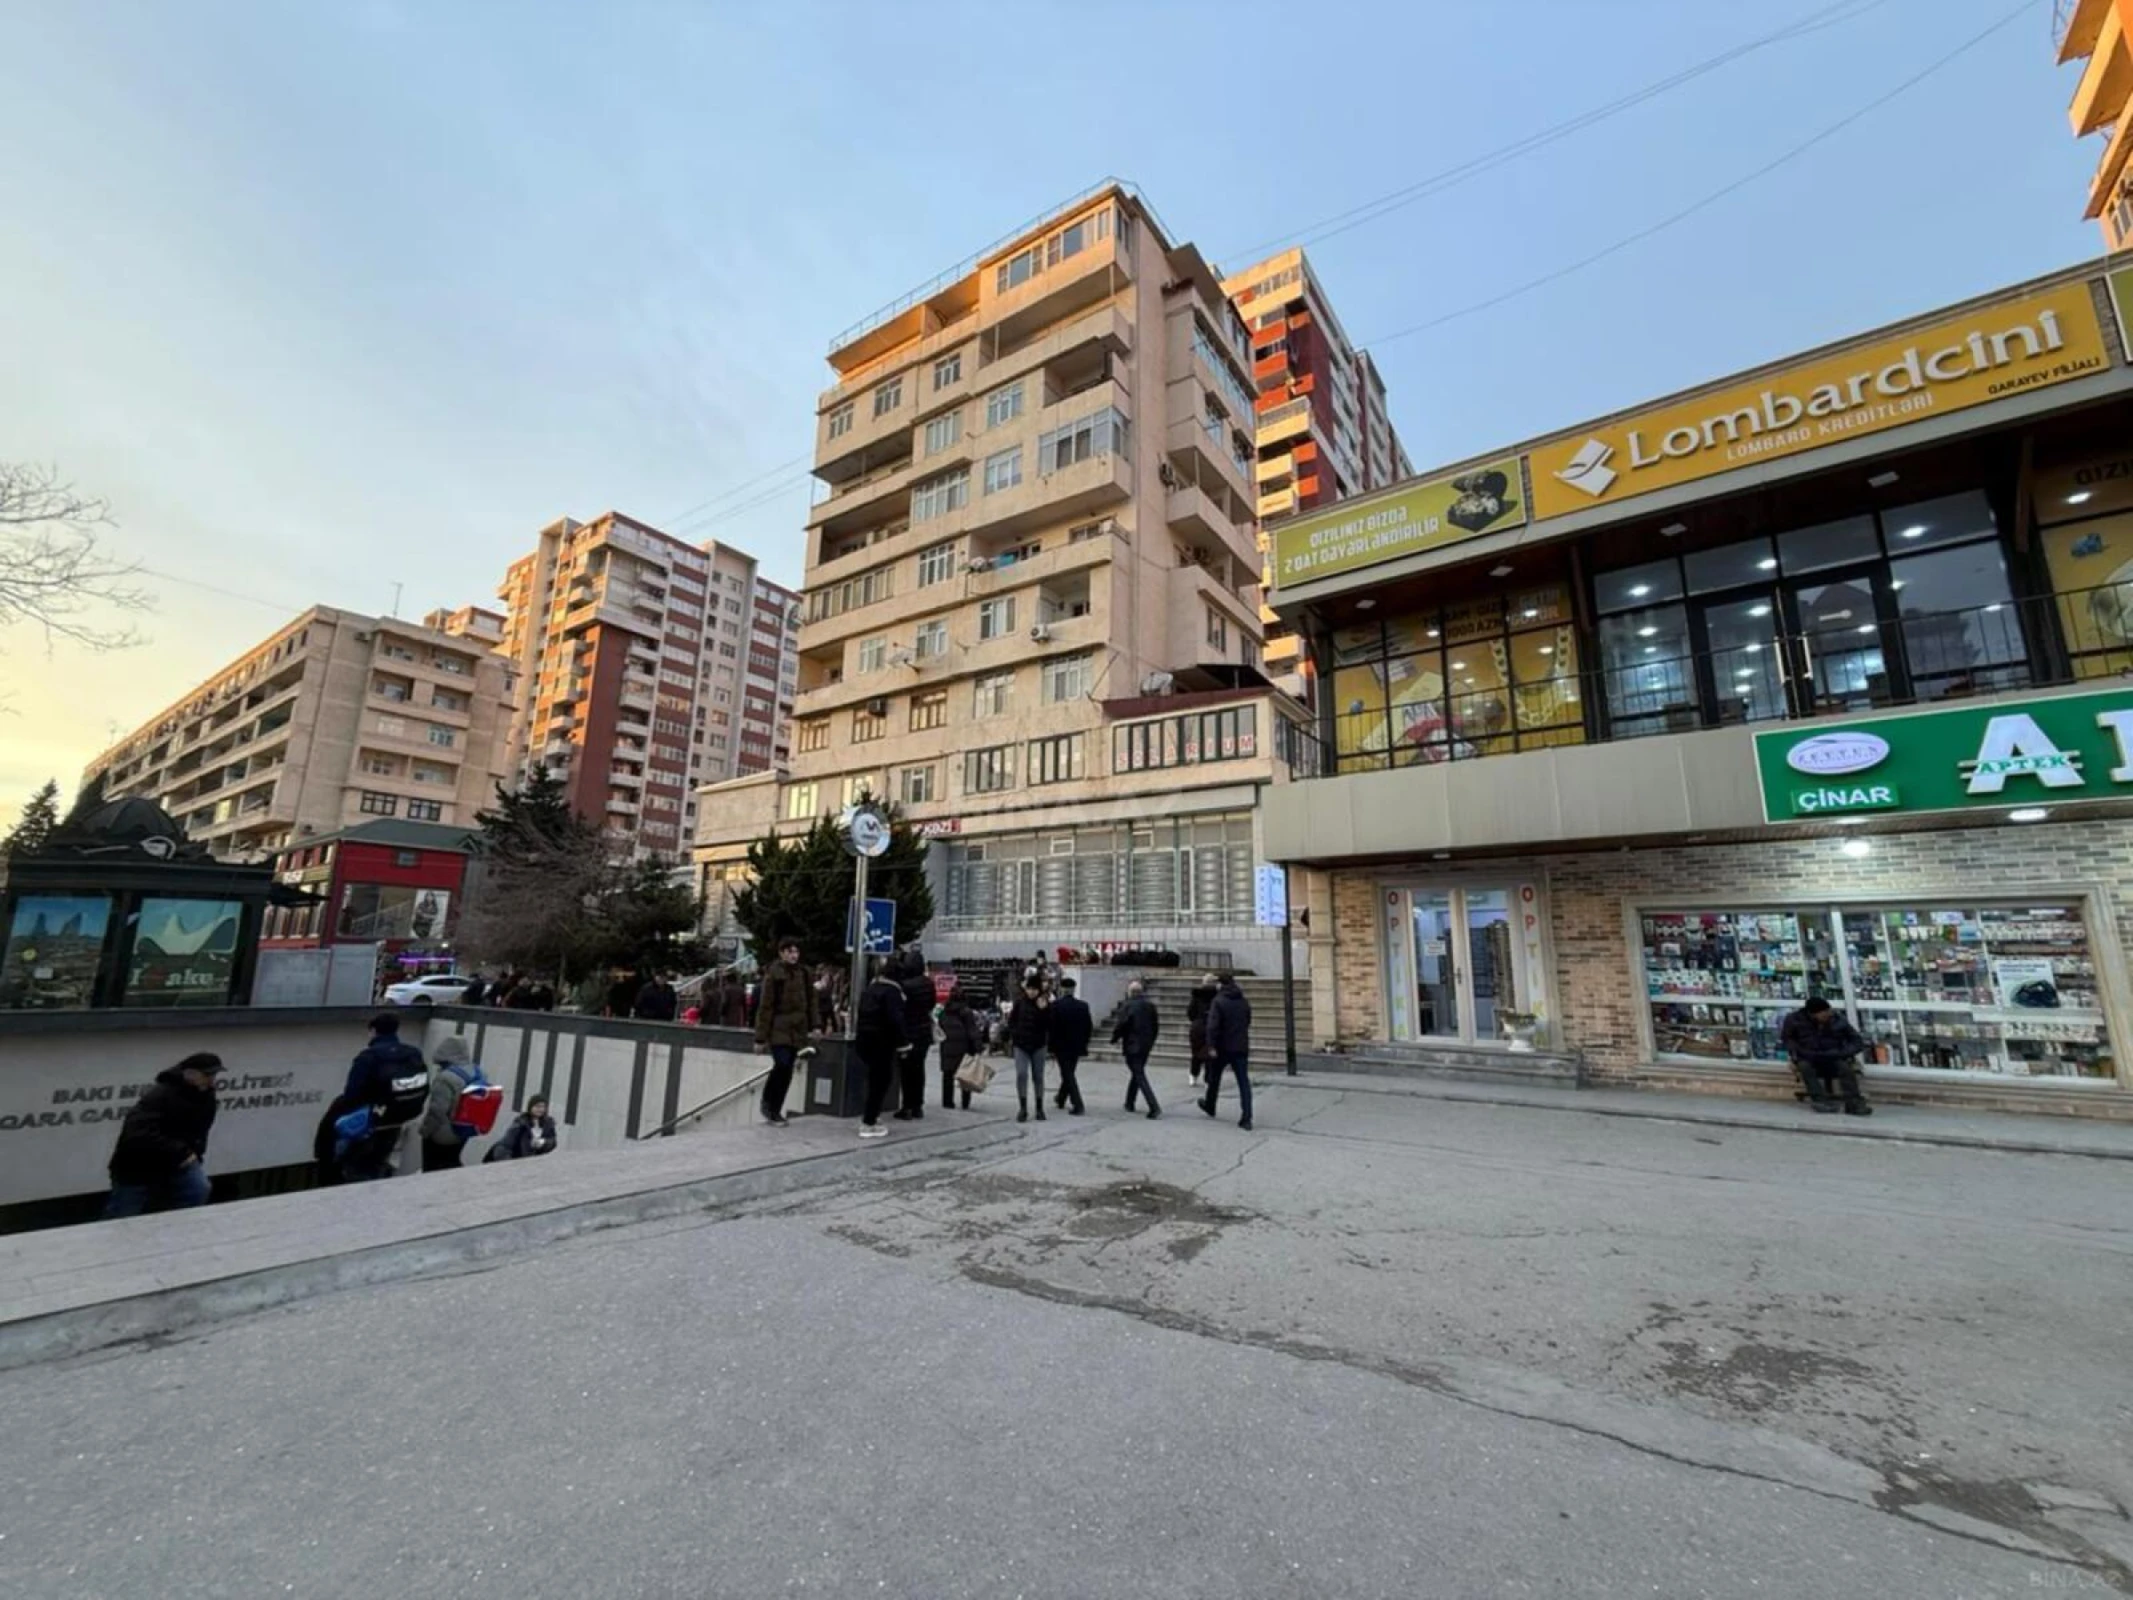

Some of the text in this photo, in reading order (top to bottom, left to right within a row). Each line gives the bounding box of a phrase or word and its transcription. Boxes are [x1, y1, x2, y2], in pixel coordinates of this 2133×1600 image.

[1988, 371, 2049, 395] QARAYEV
[1727, 427, 1811, 462] LOMBARD
[2075, 457, 2133, 486] QIZI
[1294, 552, 1318, 572] QAT
[1978, 755, 2067, 776] APTEK
[1797, 785, 1894, 812] ÇİNAR
[52, 1085, 114, 1105] BAKI
[0, 1109, 74, 1131] QARA
